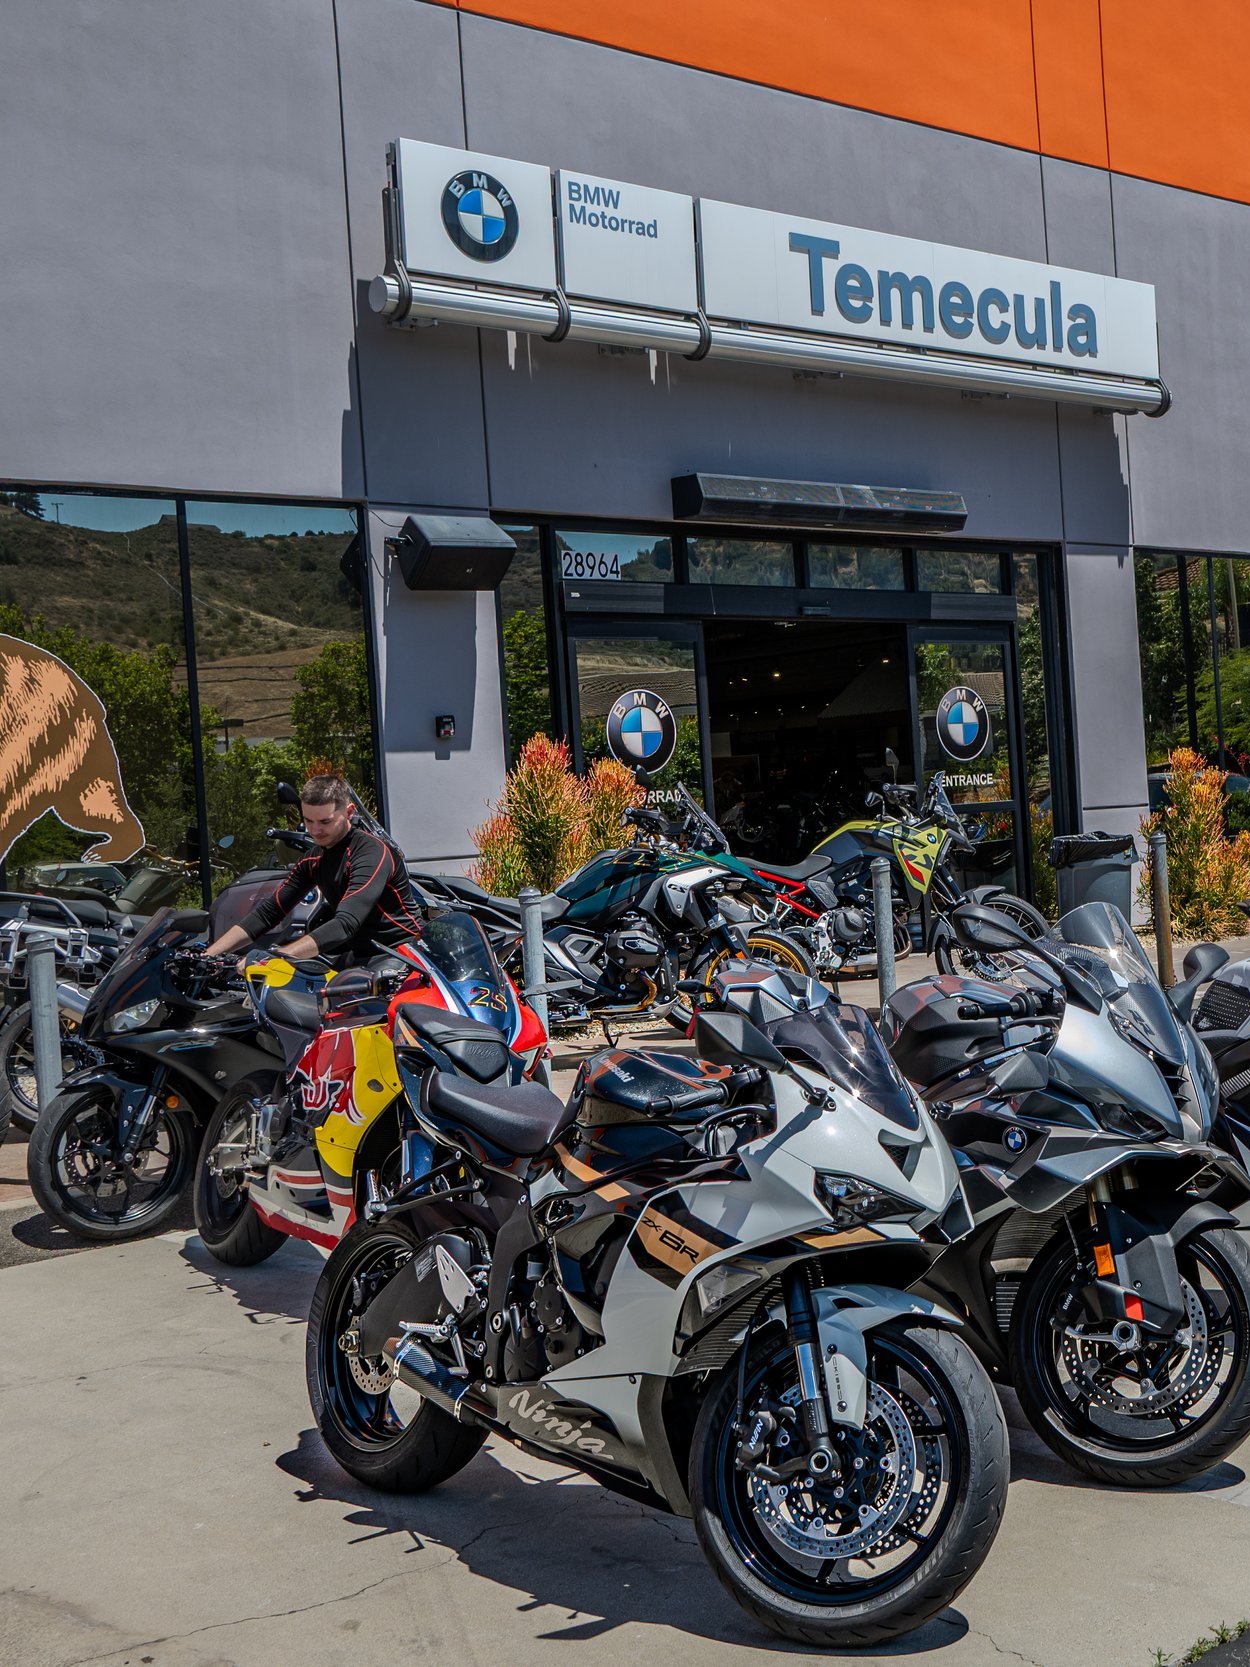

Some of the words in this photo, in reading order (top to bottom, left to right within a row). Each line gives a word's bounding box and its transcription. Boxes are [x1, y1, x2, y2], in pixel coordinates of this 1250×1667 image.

[448, 172, 513, 208] BMW
[567, 181, 621, 210] BMW
[568, 203, 658, 239] Motorrad
[788, 232, 1098, 358] Temecula
[562, 551, 621, 579] 28964
[612, 692, 669, 720] BMW
[941, 689, 984, 713] BMW
[941, 773, 994, 787] ENTRANCE
[638, 790, 683, 804] ORRAD
[667, 883, 690, 894] GS
[600, 1054, 635, 1083] Kawasaki
[1062, 1293, 1074, 1311] BMW
[508, 1389, 615, 1460] Ninja
[748, 1418, 764, 1450] NISSIN
